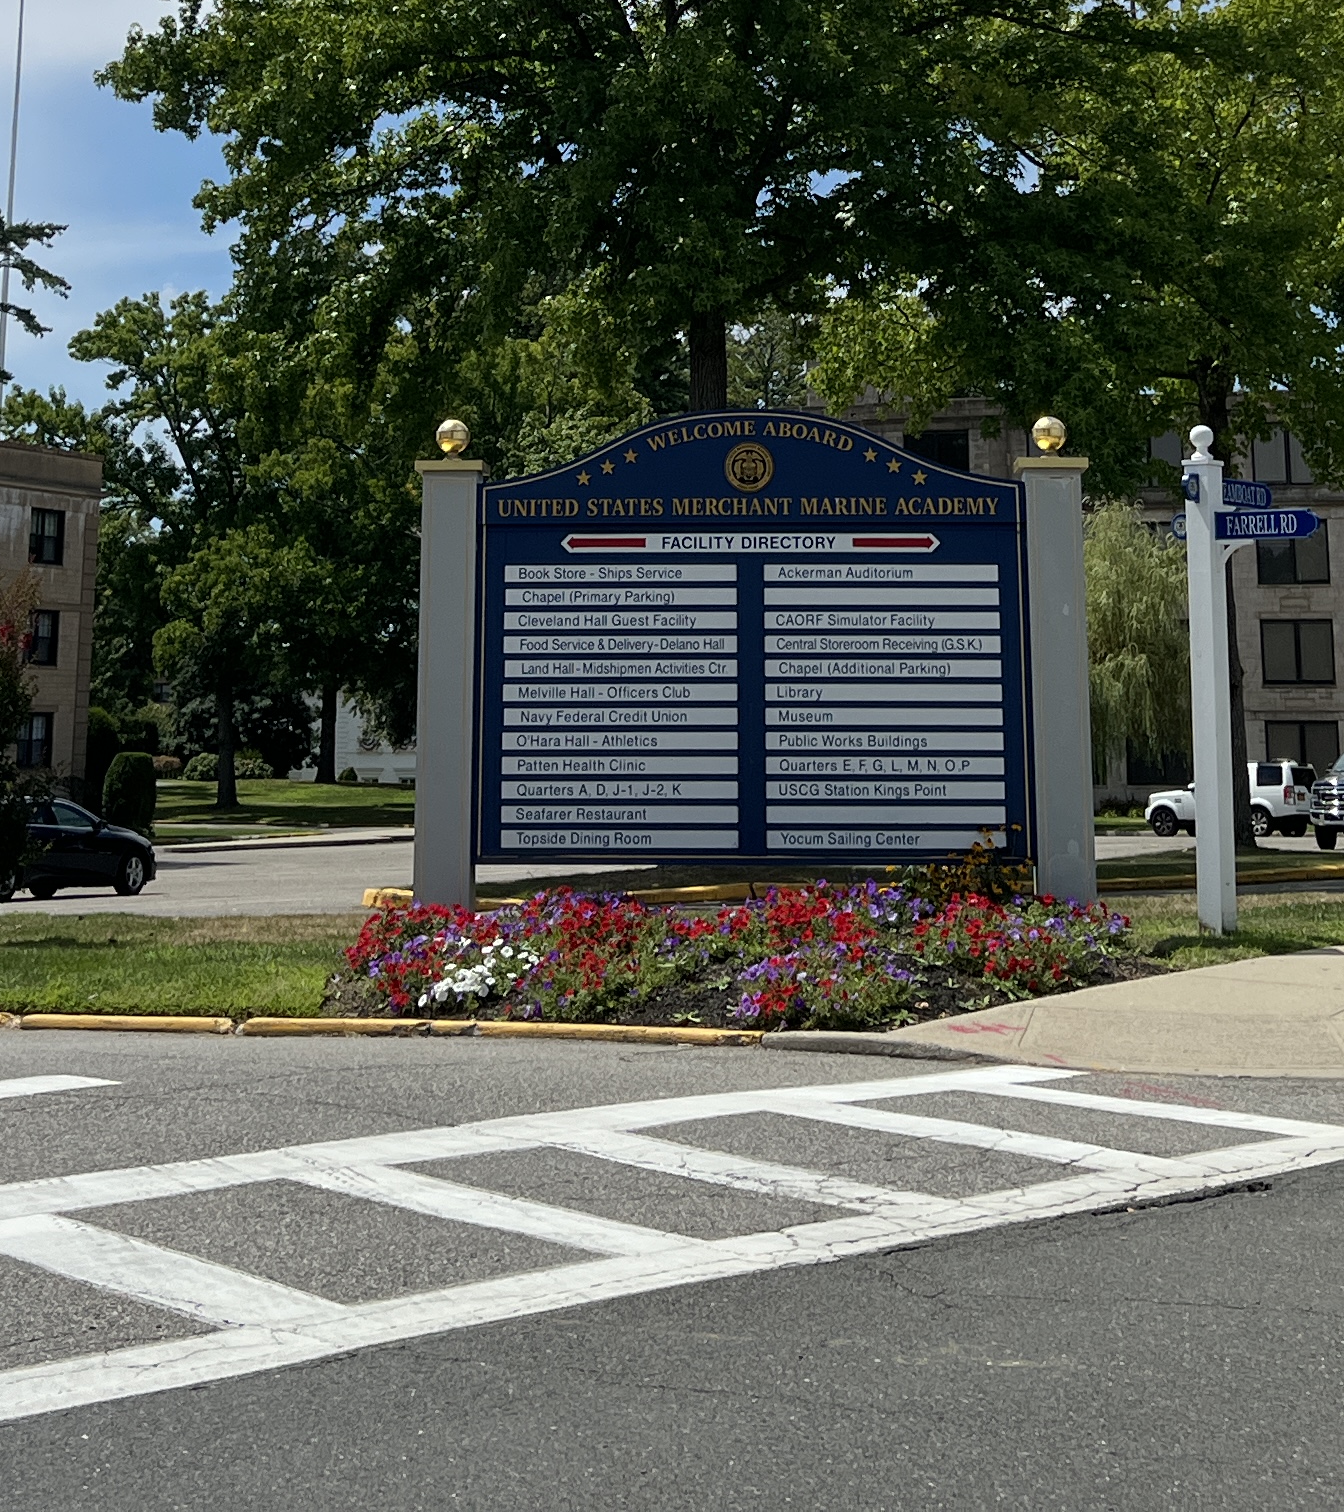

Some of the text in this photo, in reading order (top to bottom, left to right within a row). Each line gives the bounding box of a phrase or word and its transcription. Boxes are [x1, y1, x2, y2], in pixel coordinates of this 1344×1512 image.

[646, 420, 854, 452] WELCOME ABOARD
[1256, 487, 1266, 506] RD
[498, 497, 999, 517] UNITED STATES MERCHANT MARINE ACADEMY
[1226, 513, 1297, 535] FARRELL RD
[662, 537, 836, 549] FACILITY DIRECTORY
[519, 568, 550, 579] Book
[554, 568, 586, 579] Store
[598, 567, 632, 581] Ships
[636, 567, 682, 579] Service
[778, 567, 913, 579] Ackerman Auditorium
[522, 591, 675, 605] Chapel (Primary Parking)
[518, 614, 697, 629] Cleveland Hall Guest Facility
[776, 614, 935, 629] CAORF Simulator Facility
[520, 639, 548, 651] Food
[552, 639, 594, 651] Service
[598, 639, 605, 650] &
[703, 638, 724, 650] Hall
[776, 638, 816, 650] Central
[820, 638, 879, 650] Storeroom
[883, 638, 938, 653] Receiving
[522, 663, 549, 674] Land
[655, 662, 705, 674] Activities
[779, 662, 951, 677] Chapel (Additional Parking)
[518, 687, 566, 698] Melville
[571, 687, 594, 698] Hall
[607, 686, 658, 698] Officers
[662, 686, 690, 698] Club
[777, 686, 823, 701] Library
[521, 710, 687, 725] Navy Federal Credit Union
[779, 710, 833, 722] Museum
[517, 735, 560, 747] O'Hara
[565, 735, 589, 747] Hall
[602, 735, 658, 747] Athletics
[779, 735, 927, 750] Public Works Buildings
[517, 759, 646, 771] Patten Health Clinic
[780, 759, 837, 772] Quarters
[843, 760, 856, 773] E,
[859, 760, 867, 773] F,
[873, 759, 886, 773] G,
[891, 760, 902, 773] L,
[907, 760, 922, 773] M,
[927, 760, 940, 773] N,
[517, 784, 573, 796] Quarters
[579, 784, 591, 798] A,
[596, 784, 608, 798] D,
[673, 784, 681, 796] K
[779, 784, 947, 799] USCG Station Kings Point
[516, 808, 647, 820] Seafarer Restaurant
[516, 832, 651, 846] Topside Dining Room
[781, 832, 920, 847] Yocum Sailing Center
